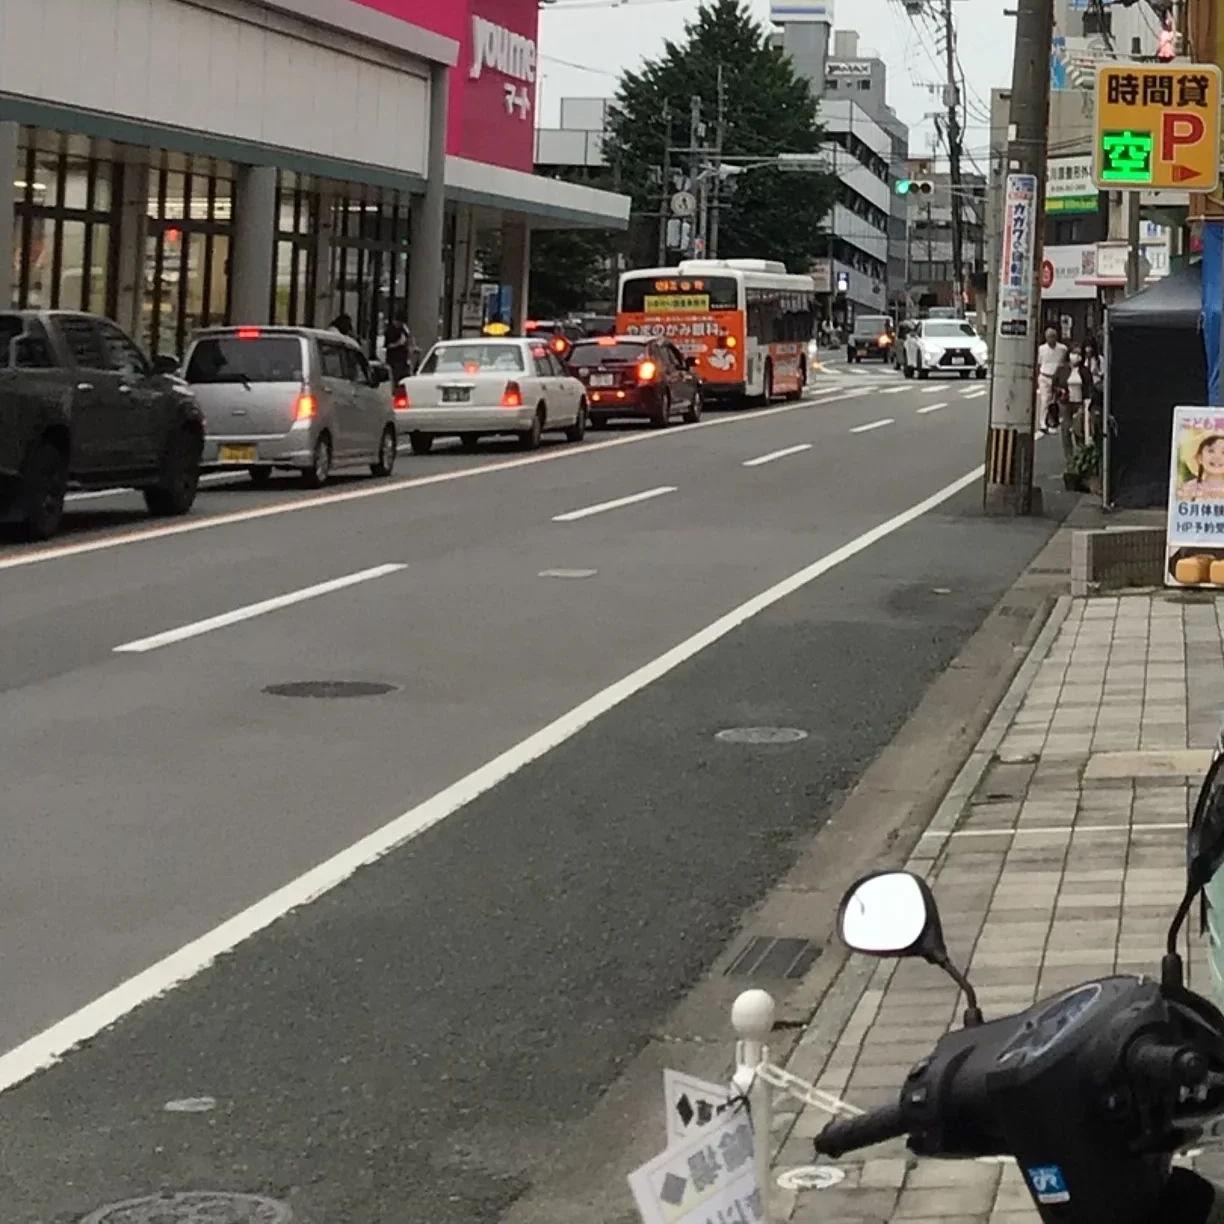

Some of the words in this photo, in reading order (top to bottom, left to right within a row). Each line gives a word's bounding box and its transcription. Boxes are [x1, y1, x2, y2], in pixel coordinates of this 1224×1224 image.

[1107, 73, 1209, 107] 時間貸
[1102, 130, 1151, 181] 空
[1162, 112, 1205, 162] P
